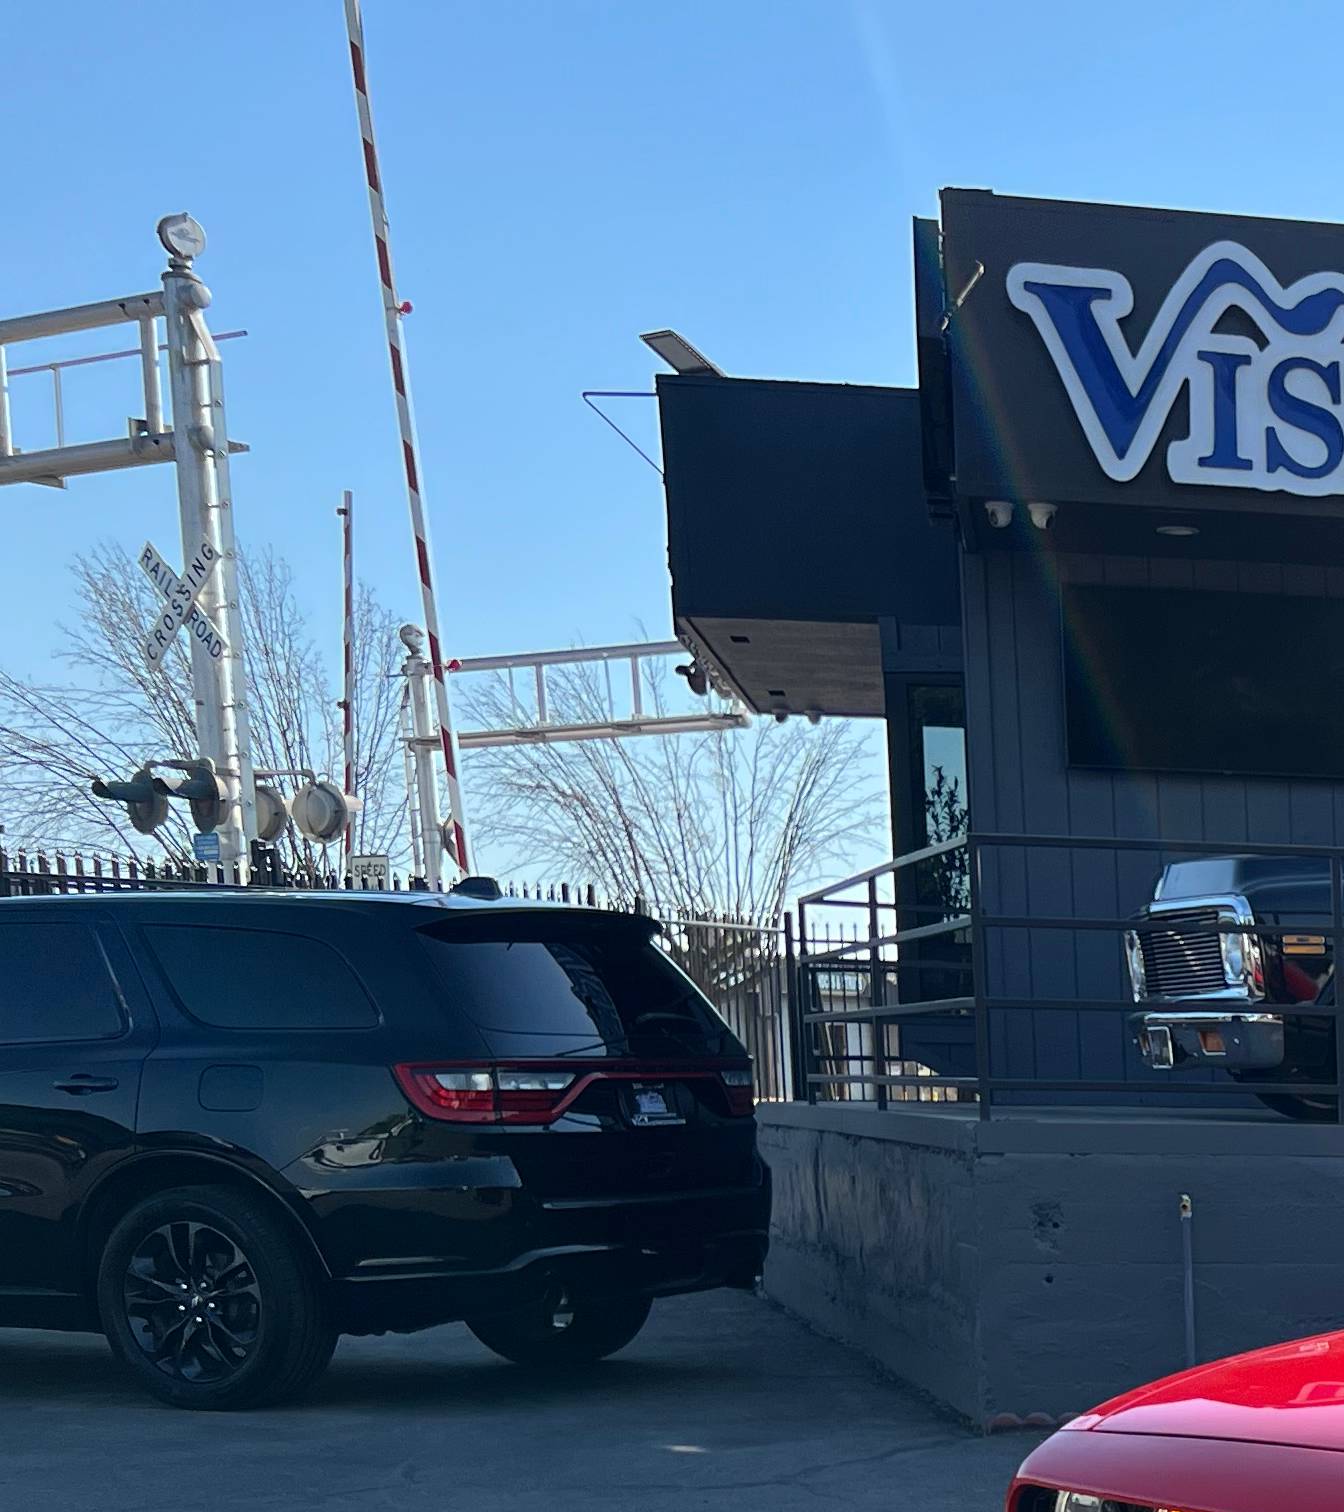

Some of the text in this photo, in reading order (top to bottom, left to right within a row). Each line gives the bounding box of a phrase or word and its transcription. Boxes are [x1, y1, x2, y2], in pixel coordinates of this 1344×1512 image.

[143, 547, 222, 657] RAIL ROAD
[147, 543, 214, 660] CROSSING
[354, 863, 387, 877] SPEED
